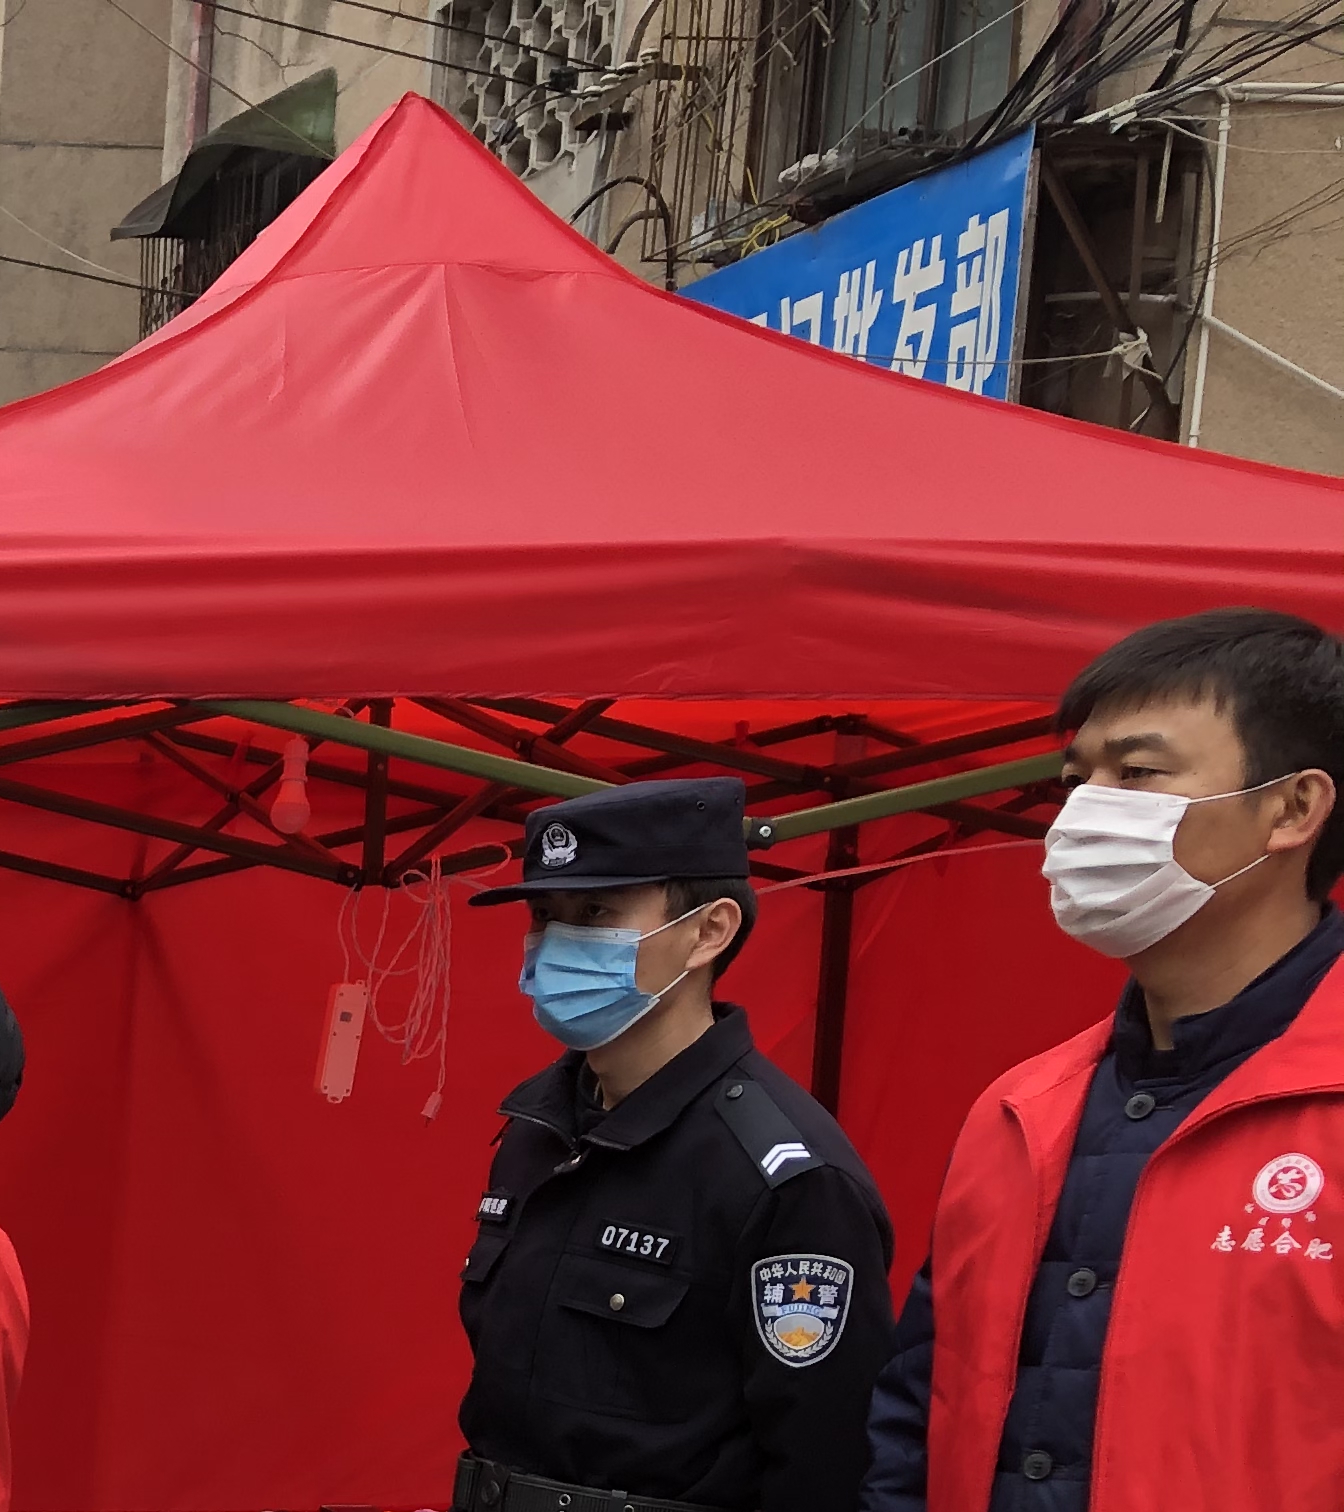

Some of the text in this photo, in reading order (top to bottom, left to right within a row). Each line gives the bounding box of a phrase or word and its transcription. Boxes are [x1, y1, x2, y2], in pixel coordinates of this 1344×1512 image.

[601, 1225, 670, 1259] 07137
[759, 1260, 847, 1285] 中华人民共和国
